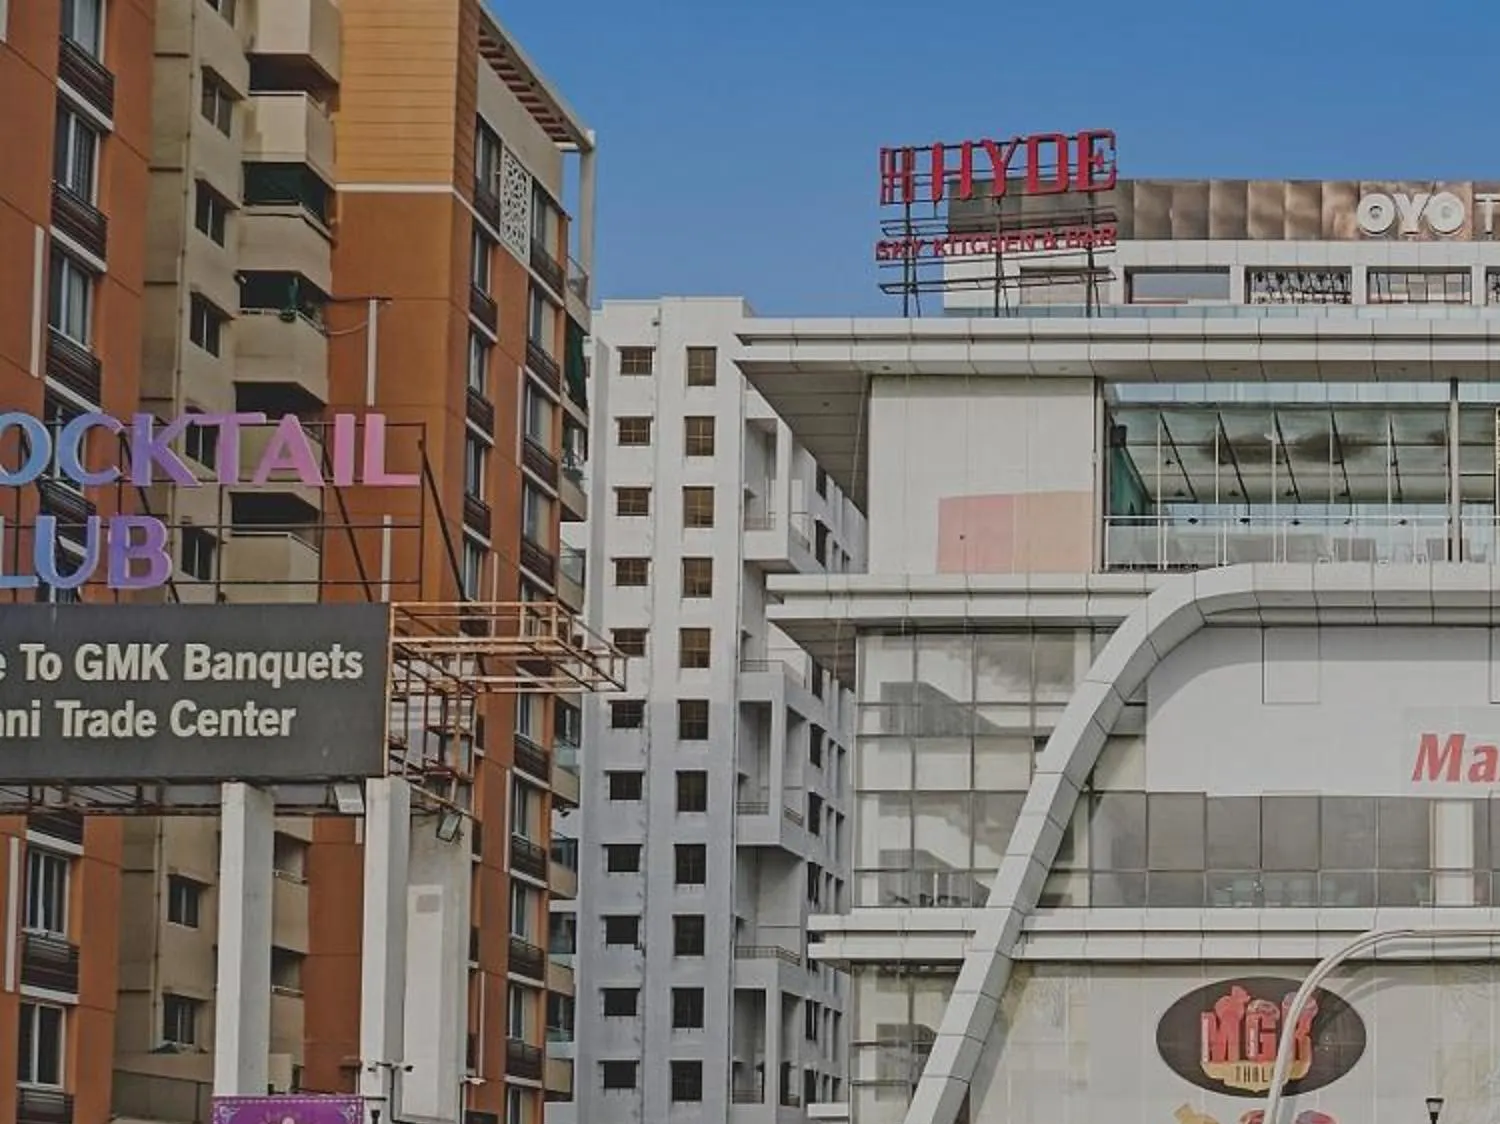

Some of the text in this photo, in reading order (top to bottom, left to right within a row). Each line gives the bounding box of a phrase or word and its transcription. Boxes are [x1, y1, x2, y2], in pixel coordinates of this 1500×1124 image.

[1357, 192, 1465, 235] OYO
[933, 231, 1034, 256] KITCHEN
[1065, 224, 1117, 248] BAR
[19, 643, 63, 681] To
[75, 643, 170, 681] GMK
[183, 644, 364, 688] Banquets
[0, 699, 297, 738] ni Trade Center
